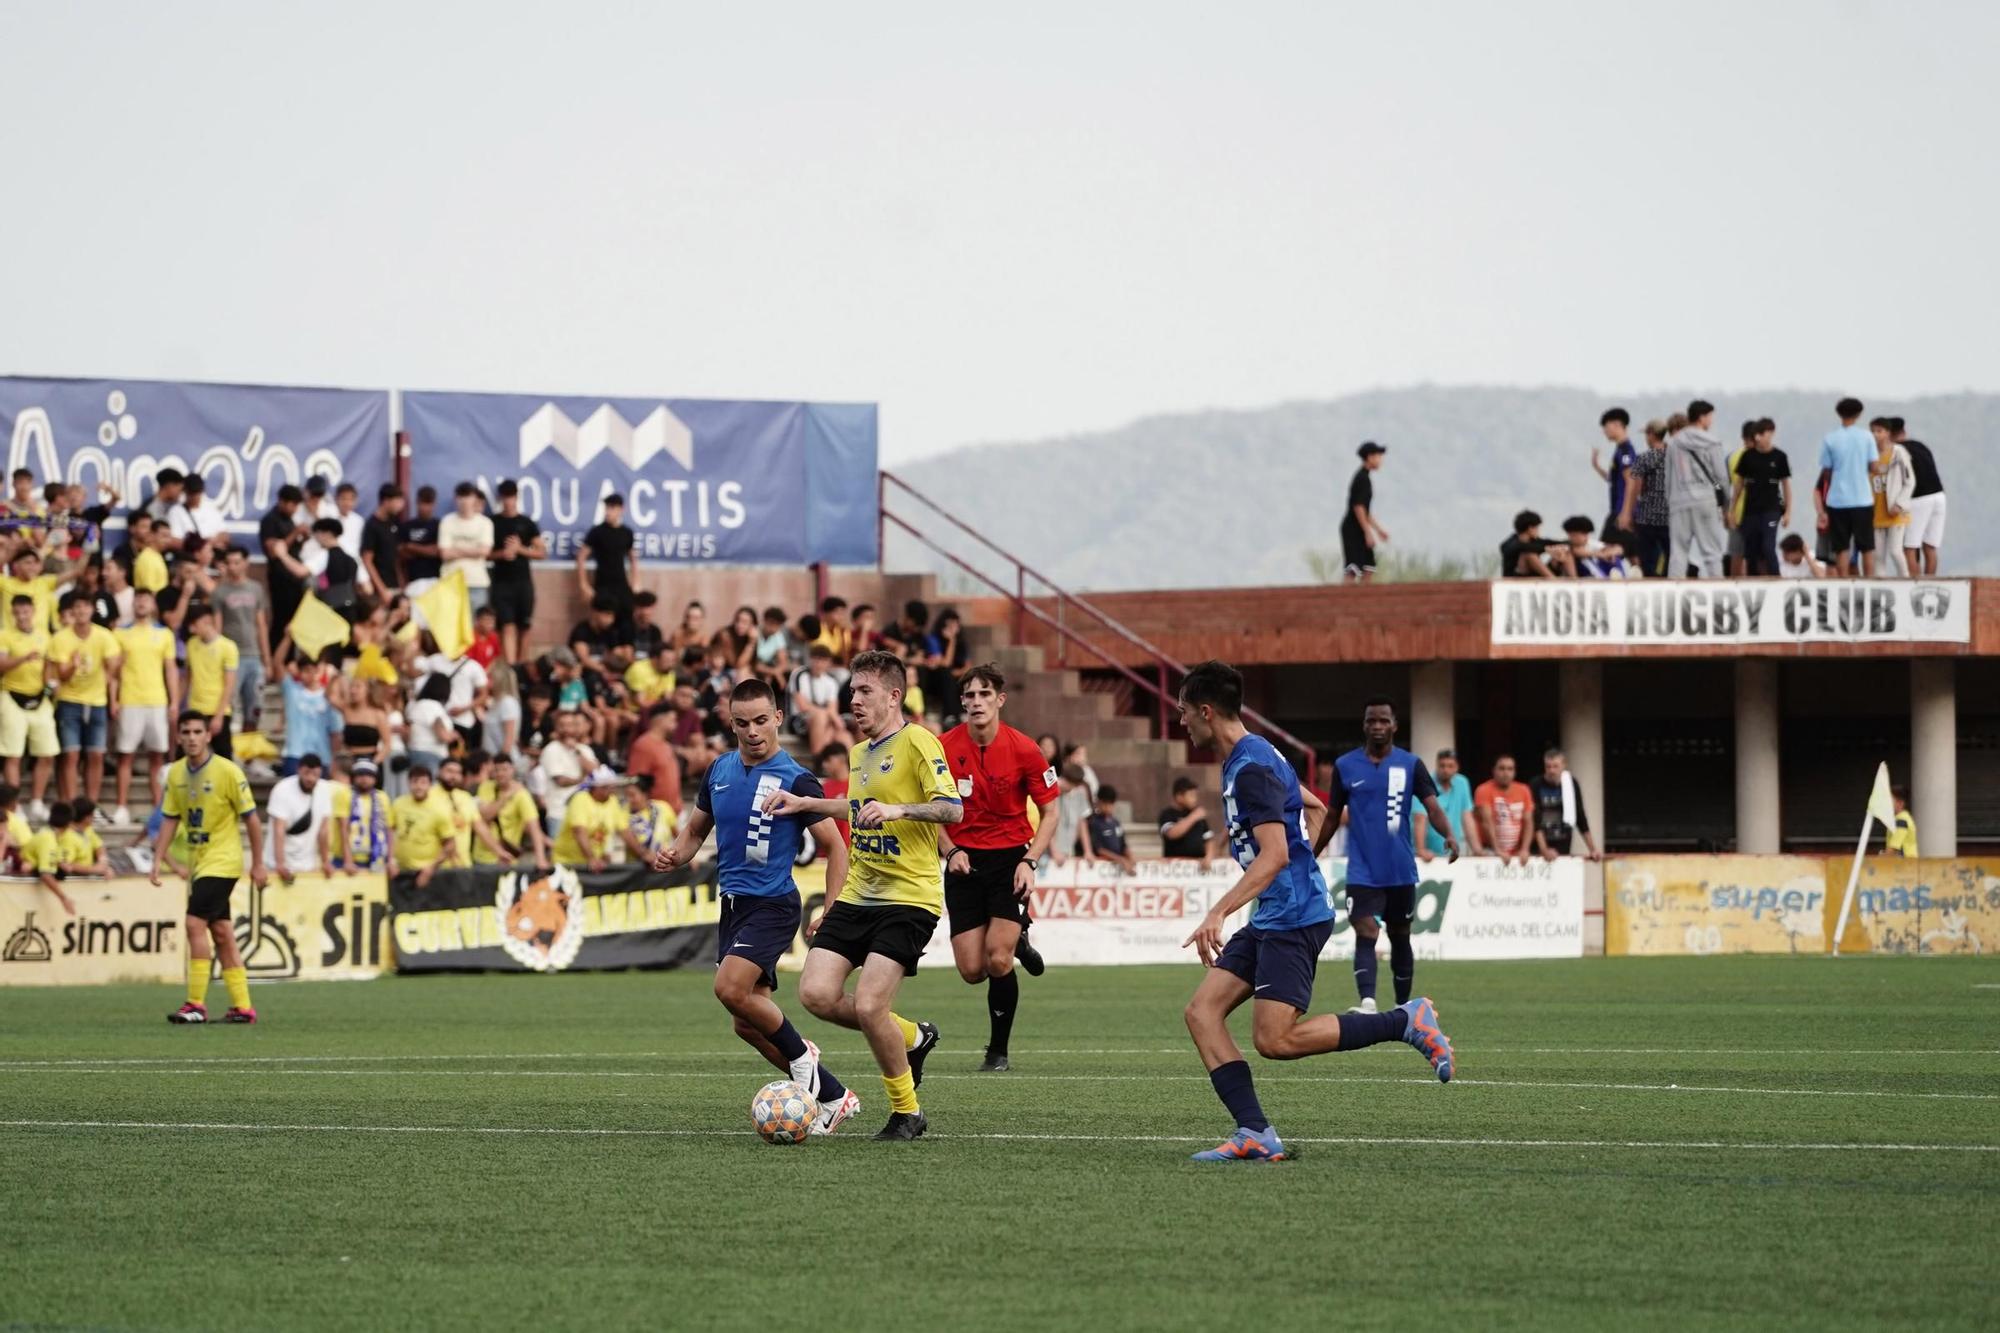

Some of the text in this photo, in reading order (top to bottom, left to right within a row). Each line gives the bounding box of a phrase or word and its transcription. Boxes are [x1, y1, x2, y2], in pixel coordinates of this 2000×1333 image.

[633, 532, 716, 559] ERVEIS
[1504, 586, 1896, 636] ANOIA RUGBY CLUB
[1711, 885, 1822, 919] super
[62, 917, 176, 954] simar
